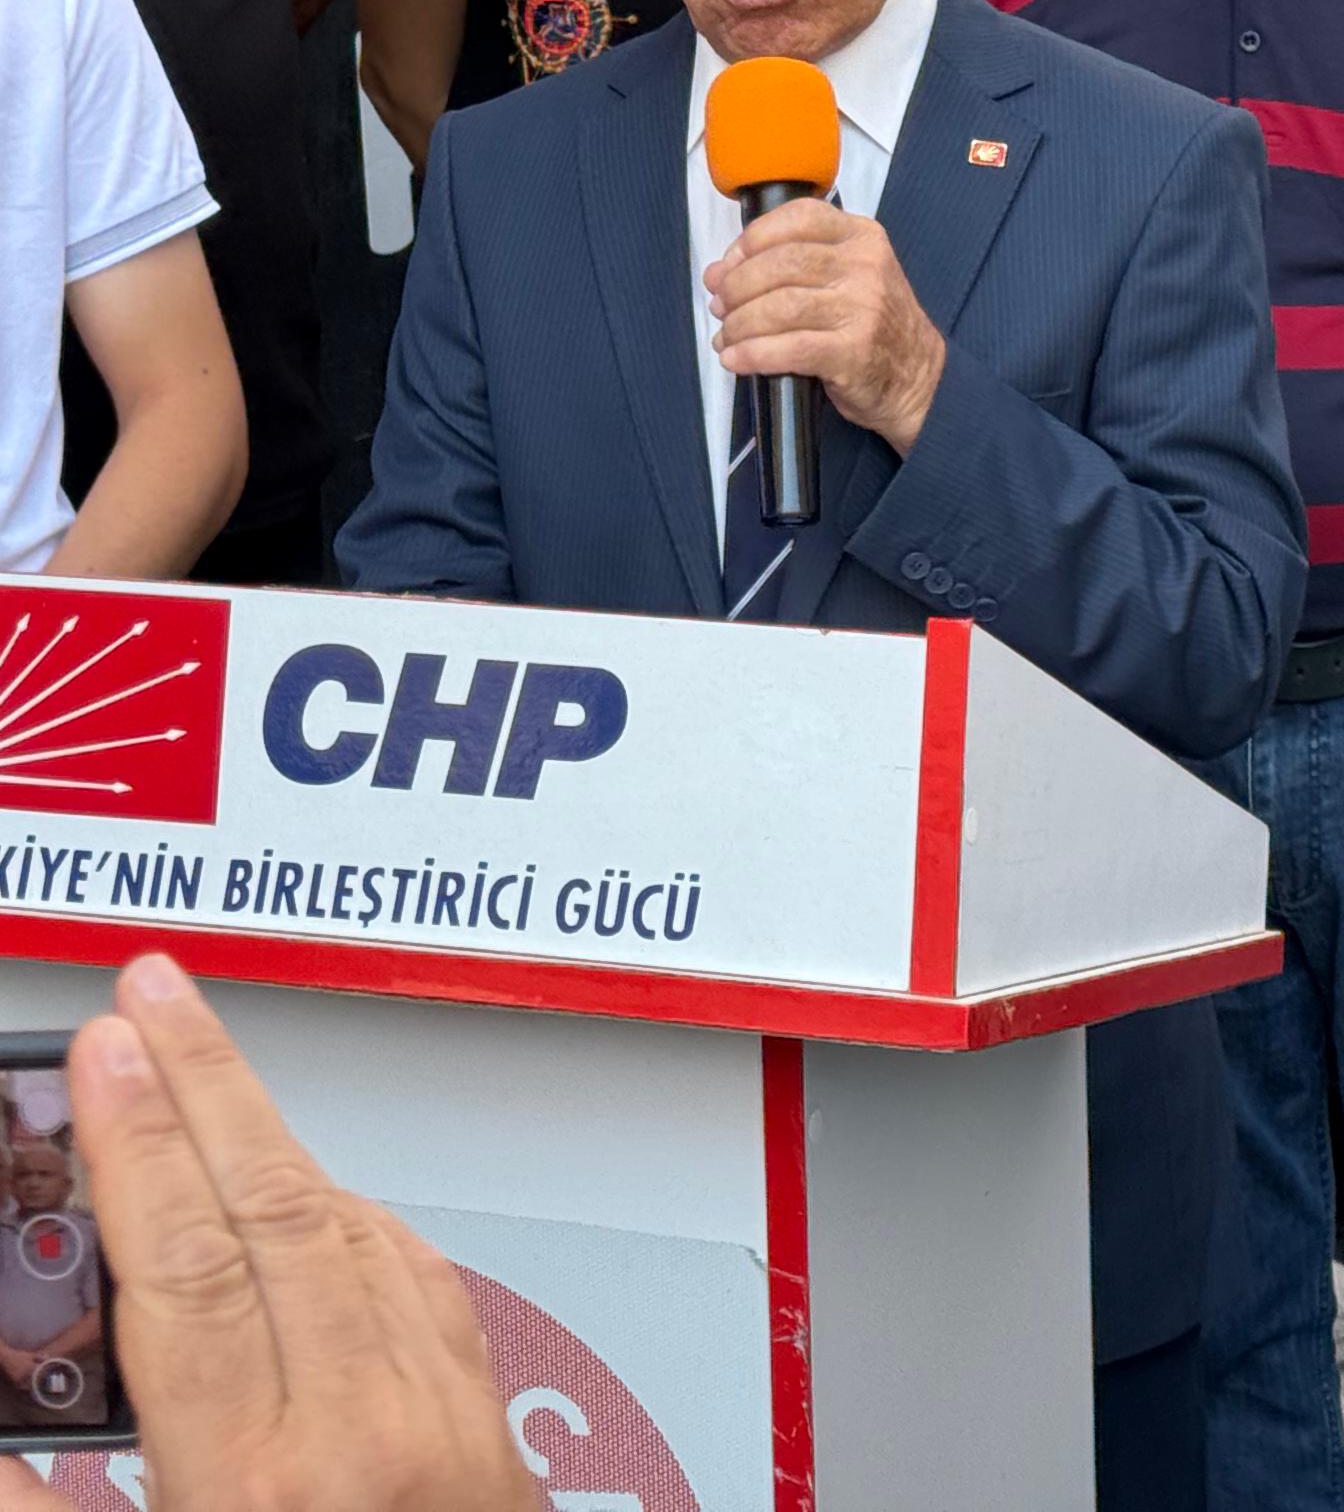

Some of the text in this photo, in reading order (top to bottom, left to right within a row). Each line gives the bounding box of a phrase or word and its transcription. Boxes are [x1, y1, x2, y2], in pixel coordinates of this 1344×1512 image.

[262, 643, 629, 801] CHP
[222, 848, 537, 929] BİRLEŞTİRİCİ
[555, 869, 702, 942] GÜCÜ
